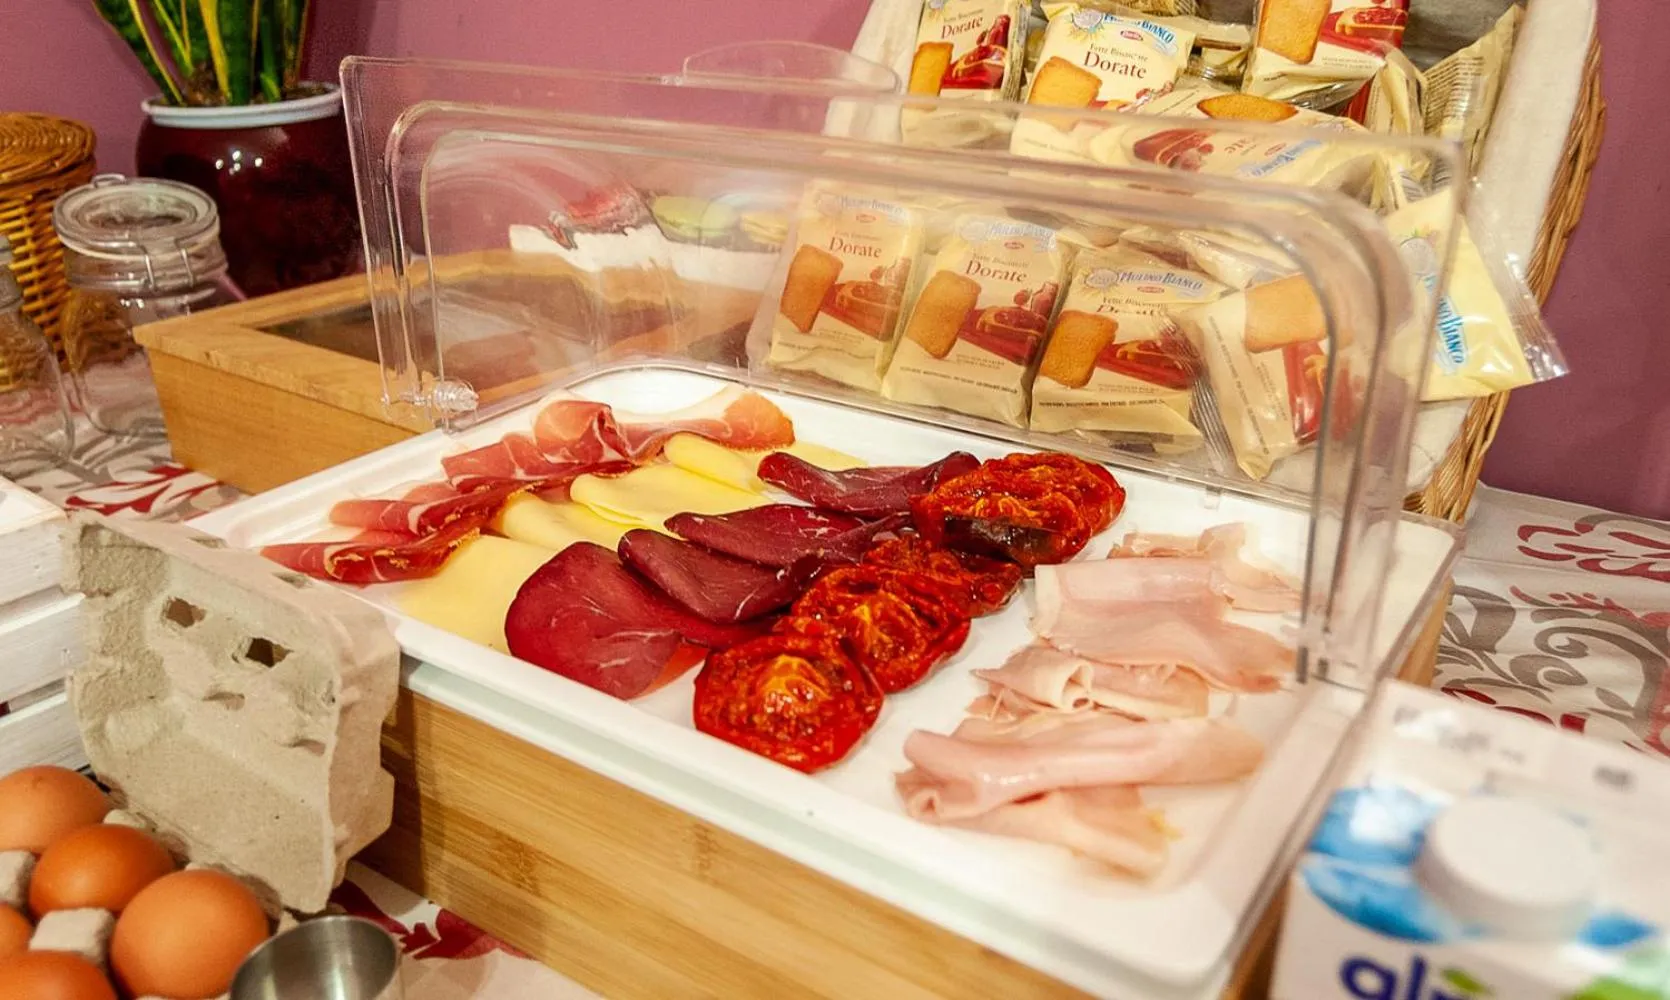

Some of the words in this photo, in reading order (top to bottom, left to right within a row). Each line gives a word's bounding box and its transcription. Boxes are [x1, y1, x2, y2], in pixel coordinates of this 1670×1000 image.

[941, 16, 983, 39] Dorate
[1141, 19, 1175, 44] BIANCO
[1083, 50, 1147, 79] Dorate
[829, 235, 882, 258] Dorate
[965, 259, 1028, 282] Dorate
[1438, 315, 1465, 364] BIANCO
